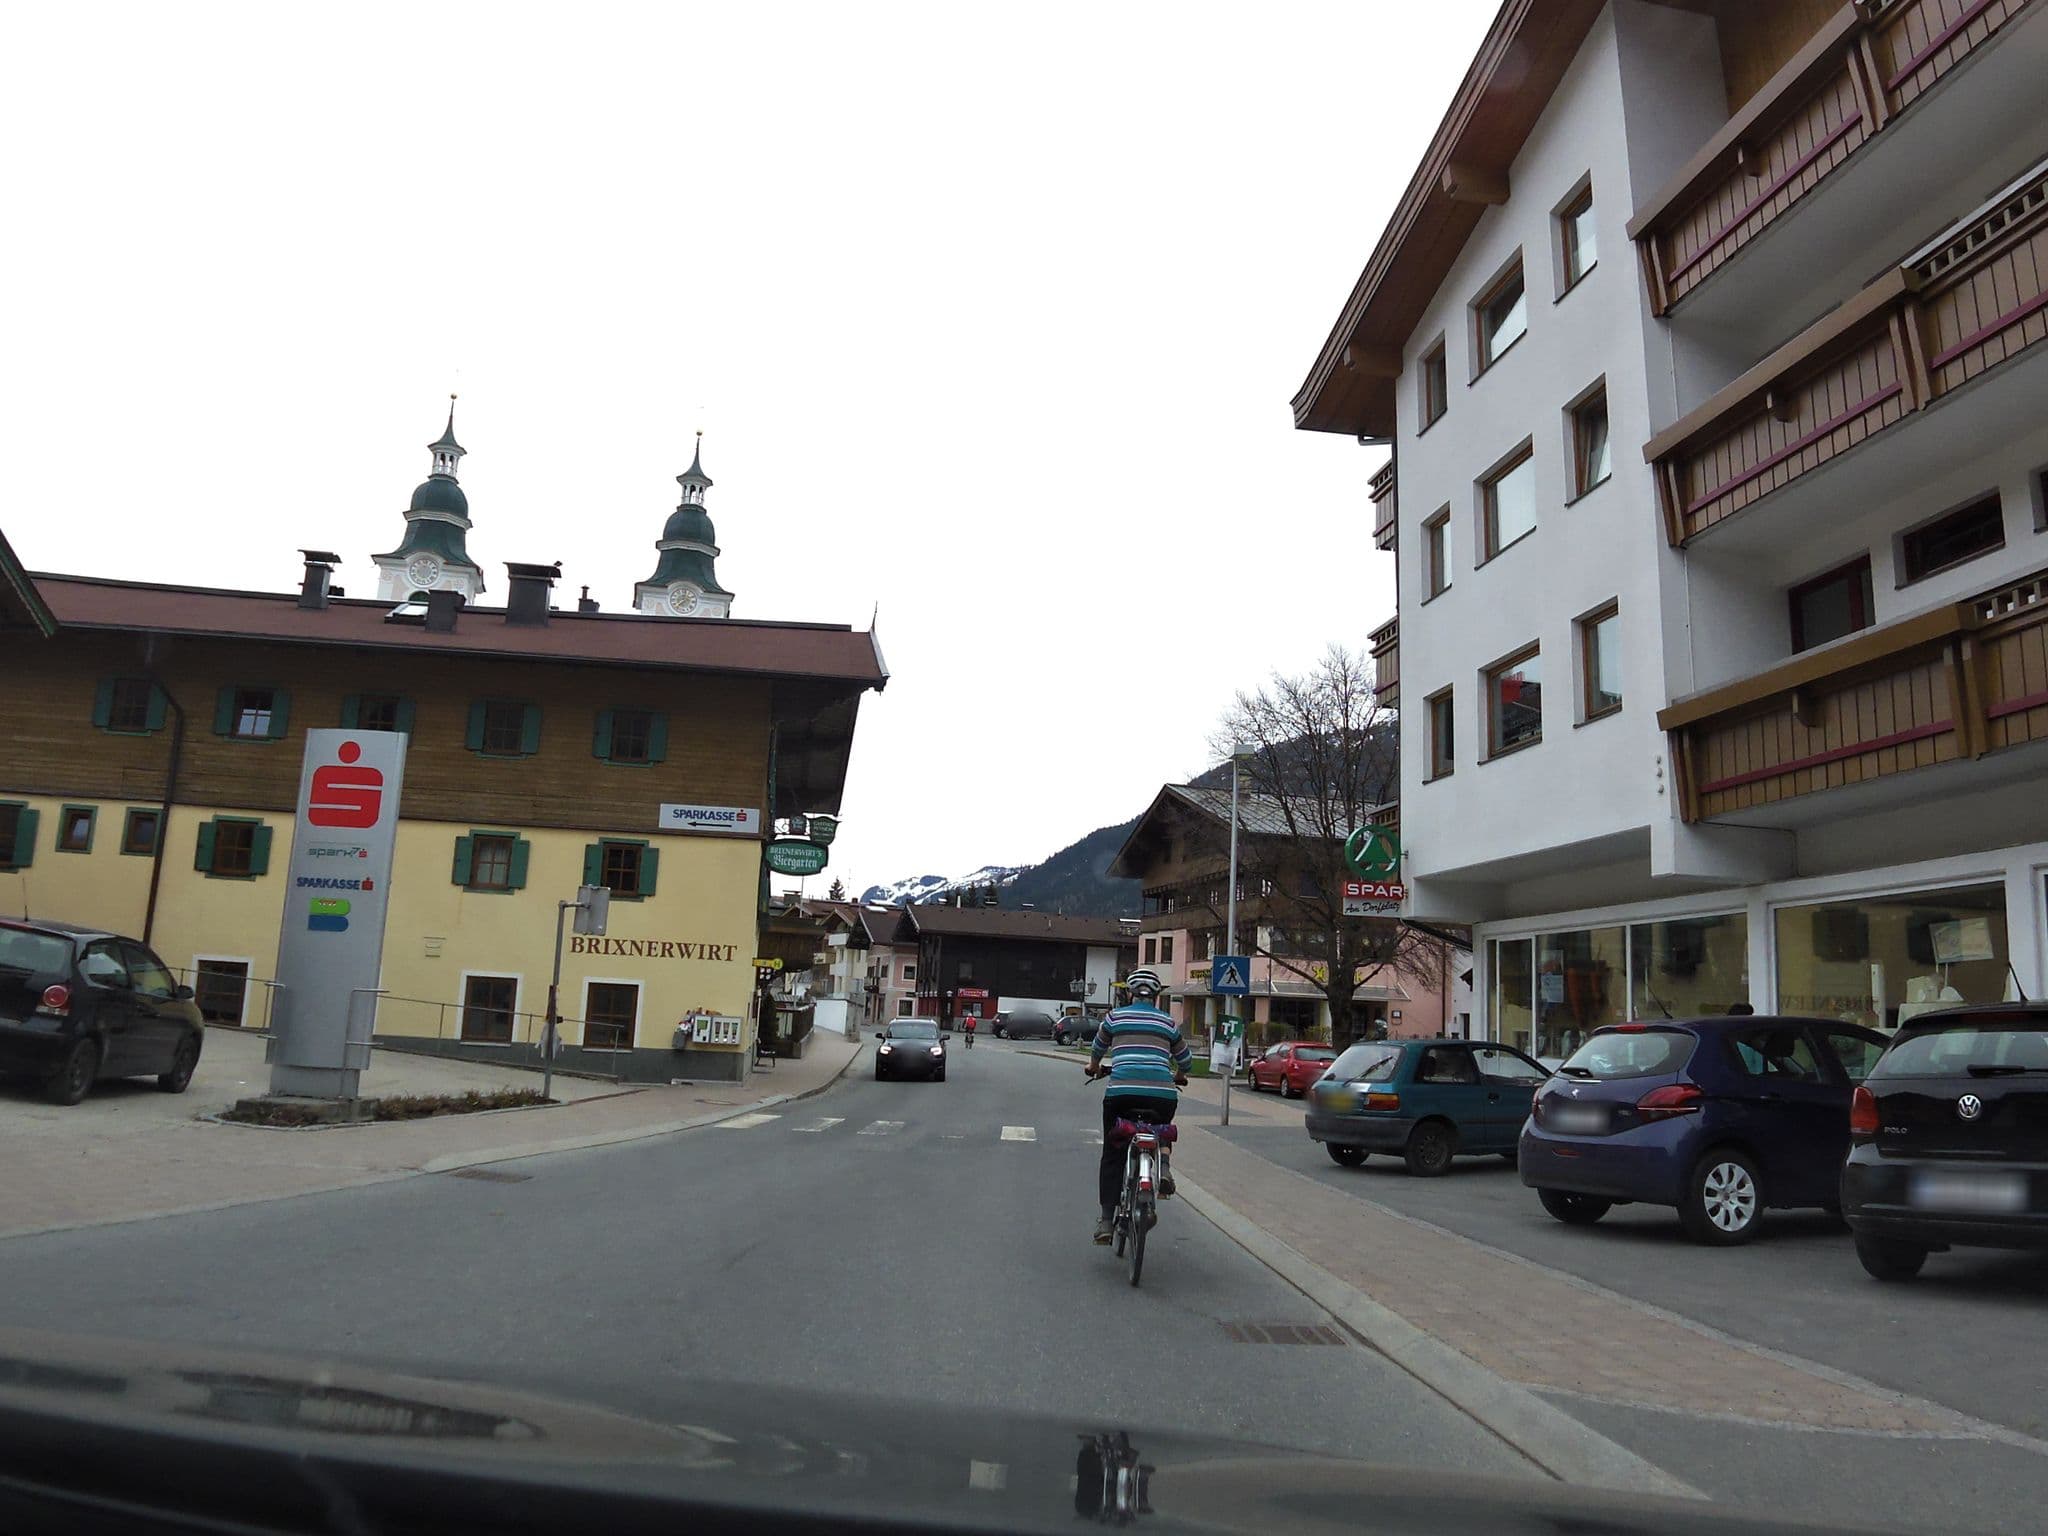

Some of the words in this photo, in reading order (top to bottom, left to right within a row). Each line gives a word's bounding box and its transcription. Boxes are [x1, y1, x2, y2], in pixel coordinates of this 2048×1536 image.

[672, 809, 735, 821] SPARKASSE
[296, 876, 361, 890] SPARKASSE
[1347, 884, 1402, 897] SPAR
[1362, 901, 1400, 914] Dorfplatz
[570, 936, 738, 962] BRIXNERWIRT
[1884, 1126, 1908, 1134] POLO
